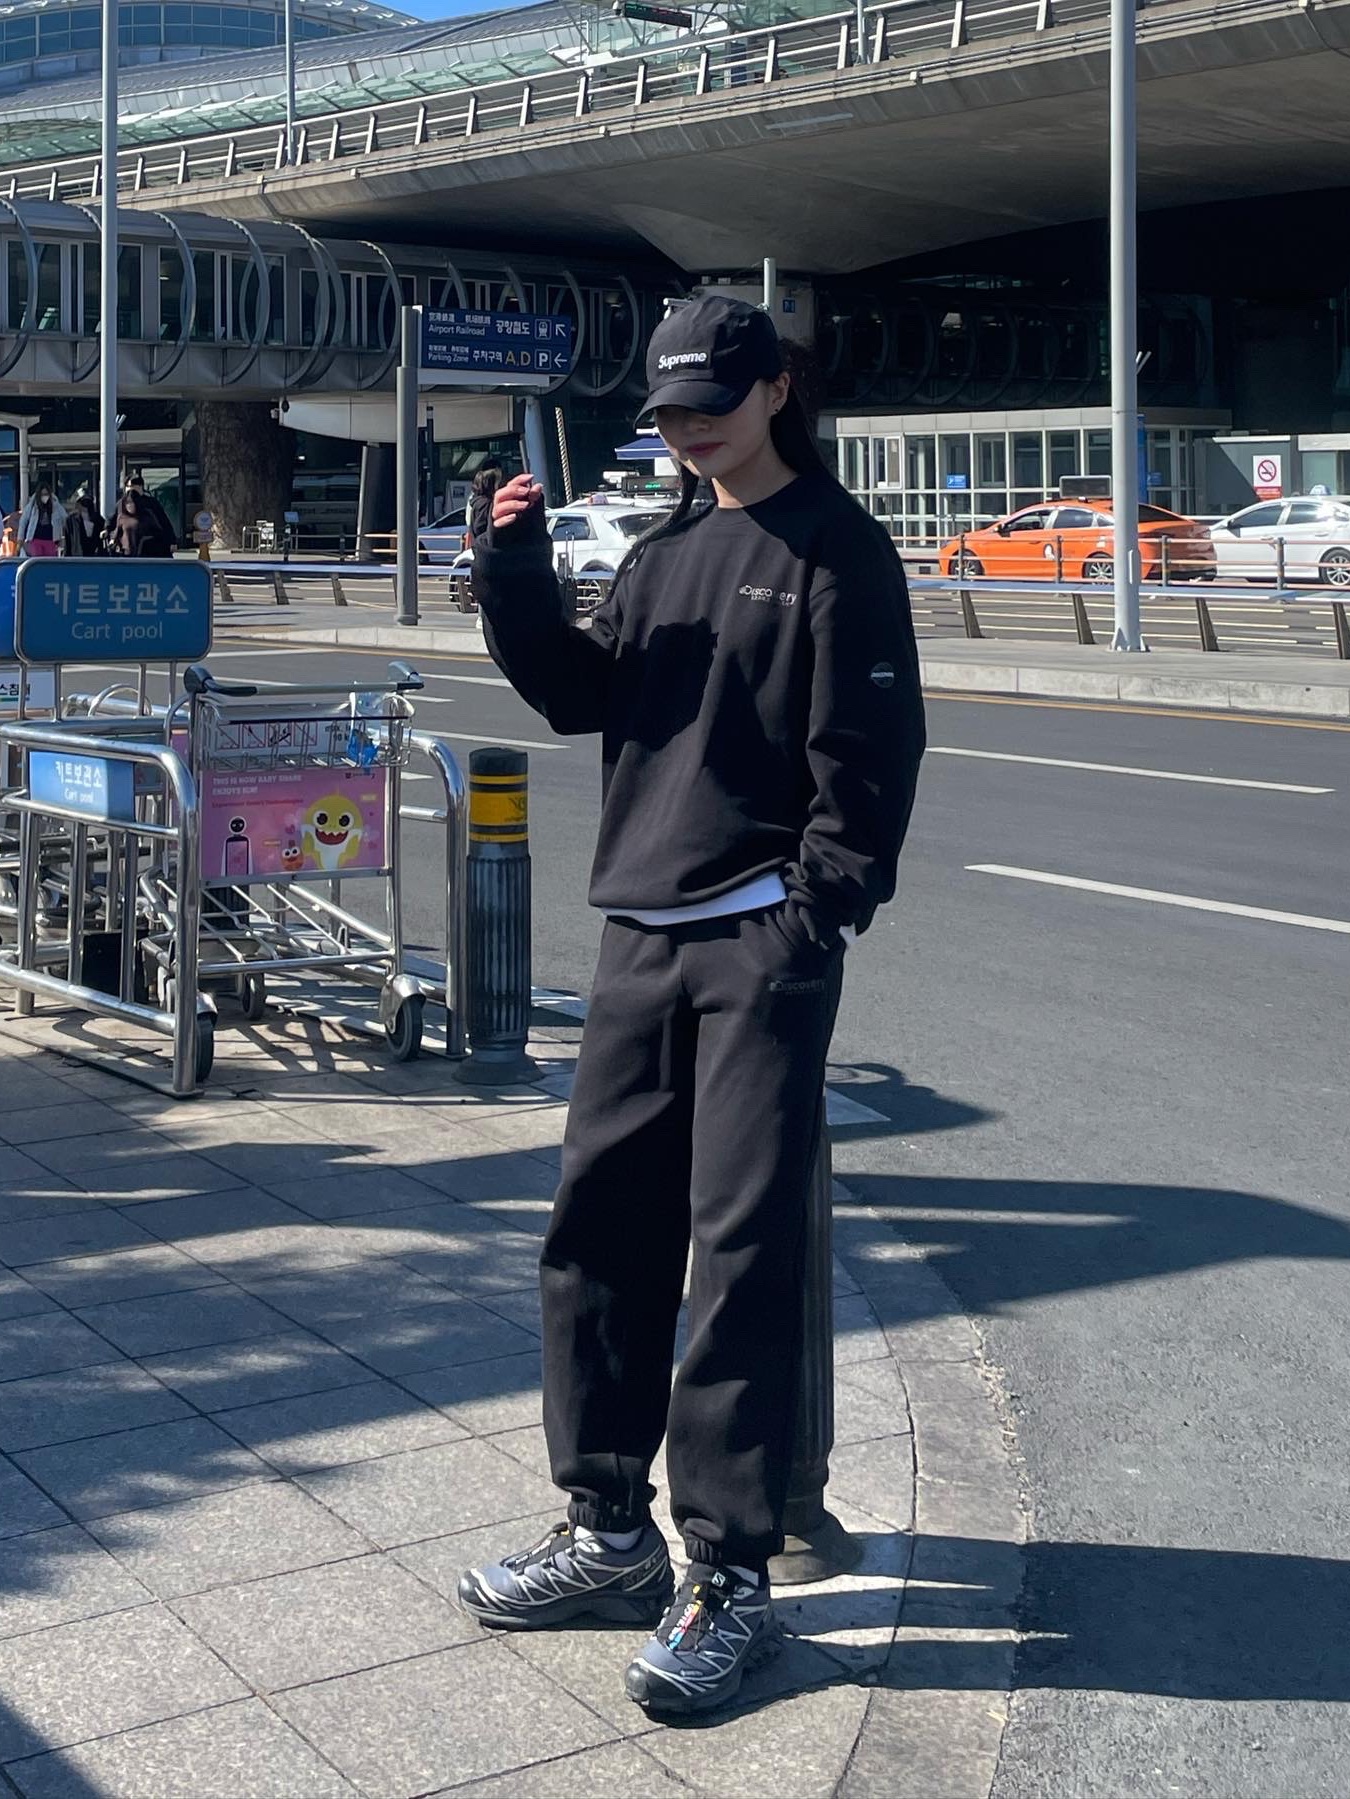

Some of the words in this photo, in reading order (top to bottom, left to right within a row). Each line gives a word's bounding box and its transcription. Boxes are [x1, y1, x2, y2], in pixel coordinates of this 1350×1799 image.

[428, 324, 455, 336] Airport
[456, 326, 485, 336] Railroad
[428, 352, 452, 364] Parking
[452, 354, 469, 363] Zone
[473, 350, 502, 363] 주차구역
[539, 352, 548, 367] P
[658, 352, 707, 370] Supreme
[45, 583, 189, 615] 카트보관소
[72, 622, 111, 639] Cart
[122, 622, 163, 643] pool
[55, 761, 103, 788] 카트보관소
